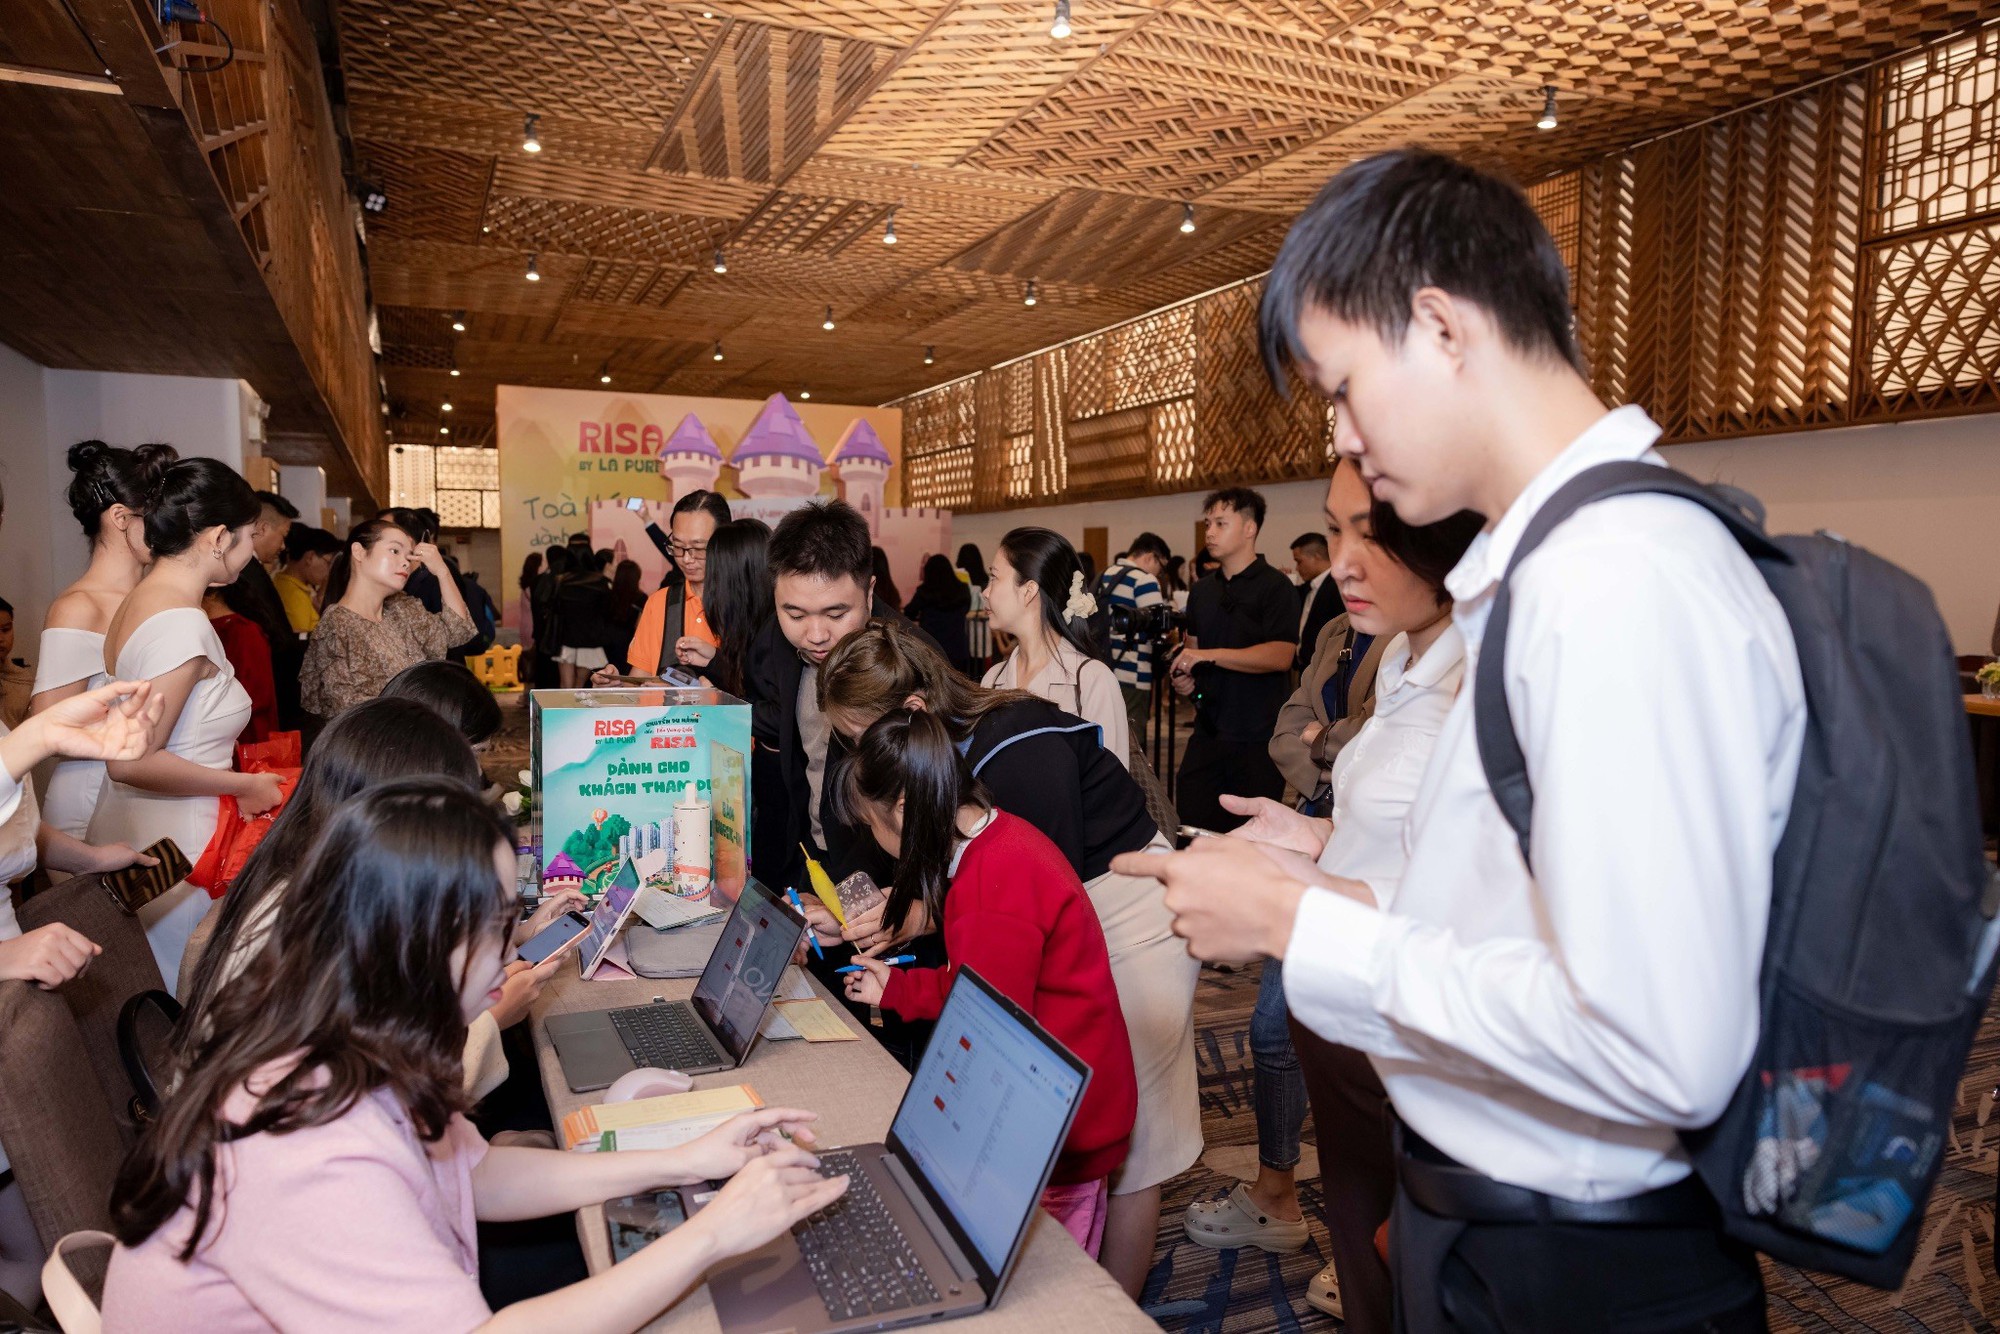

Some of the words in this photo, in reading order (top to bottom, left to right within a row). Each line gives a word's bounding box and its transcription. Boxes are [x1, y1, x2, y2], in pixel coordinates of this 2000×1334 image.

[579, 421, 664, 455] RISA
[579, 461, 593, 471] BY
[599, 458, 618, 471] LA
[523, 492, 577, 520] Toà
[594, 719, 637, 736] RISA
[650, 736, 697, 750] RISA
[607, 757, 653, 776] DÀNH
[657, 760, 690, 774] CHO
[578, 777, 637, 797] KHÁCH
